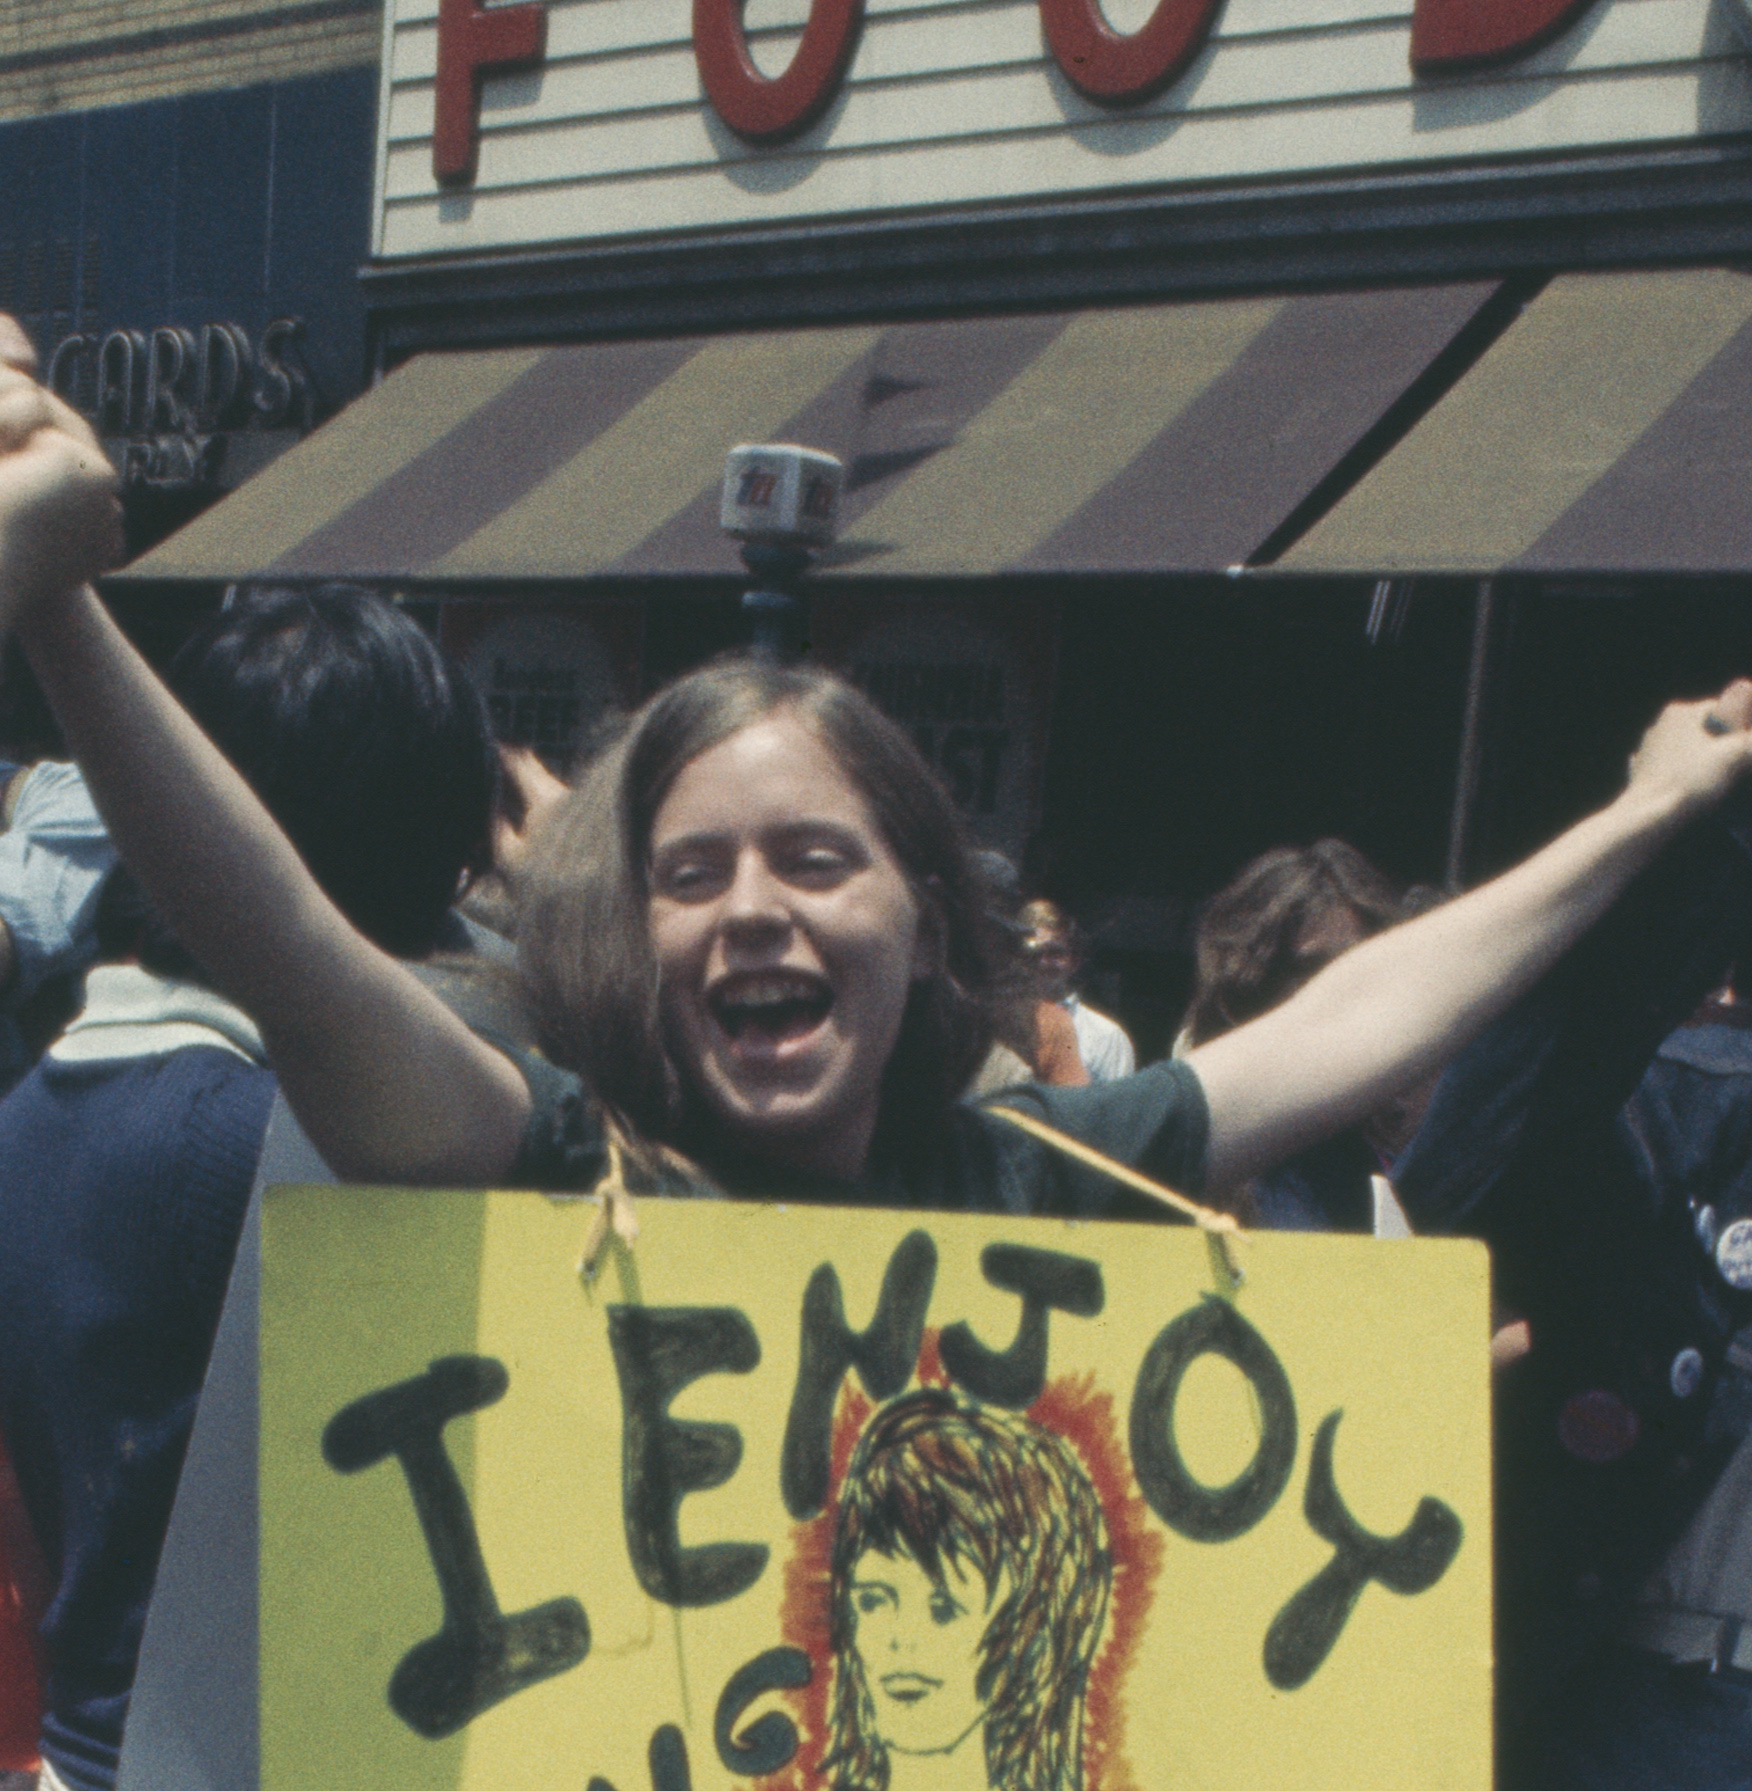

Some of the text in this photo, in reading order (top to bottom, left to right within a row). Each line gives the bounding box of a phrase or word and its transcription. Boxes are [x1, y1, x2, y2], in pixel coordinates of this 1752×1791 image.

[433, 0, 1608, 185] FO
[48, 318, 306, 428] CARDS
[320, 1352, 592, 1741] I
[608, 1228, 1465, 1692] ENJOY
